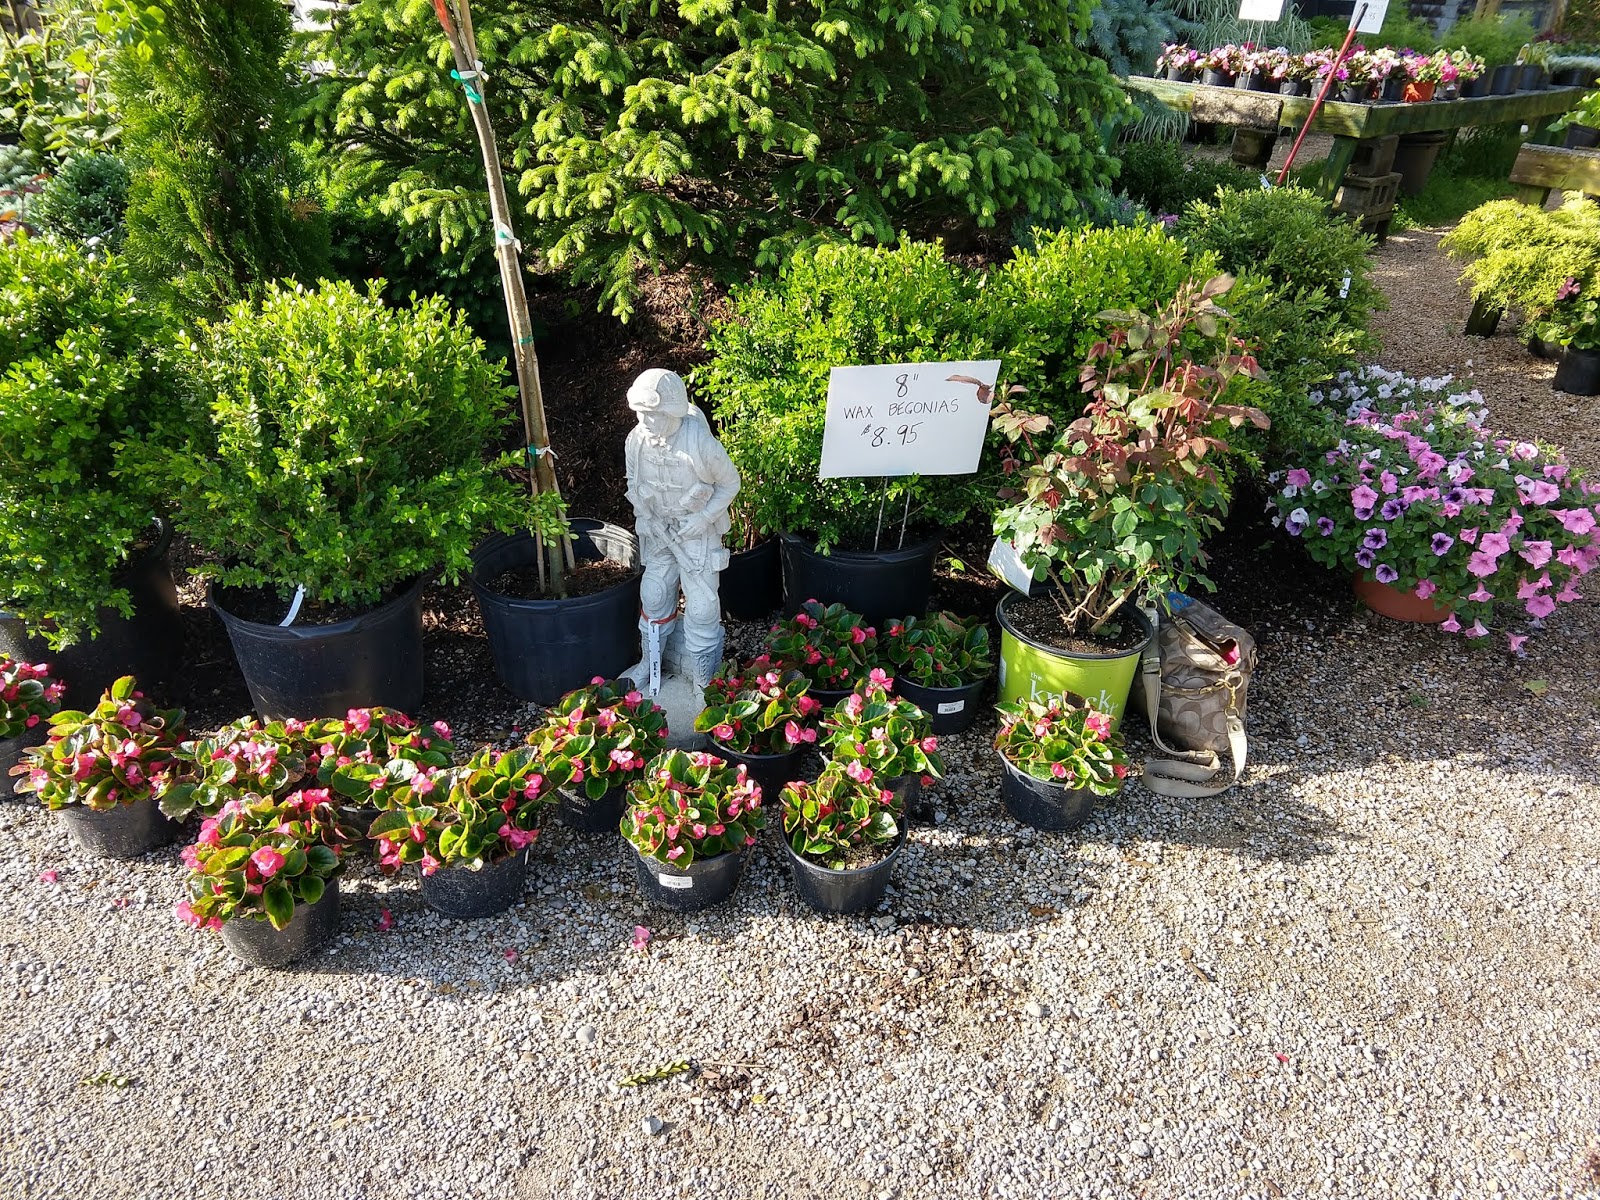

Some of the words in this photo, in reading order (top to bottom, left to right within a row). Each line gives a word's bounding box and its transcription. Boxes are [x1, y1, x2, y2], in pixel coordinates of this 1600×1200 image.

[895, 373, 919, 398] 8"
[843, 405, 874, 420] WAX
[888, 398, 959, 417] BEGONIAS
[860, 421, 924, 448] $8.95
[1030, 672, 1043, 681] the
[1030, 679, 1113, 711] knk
